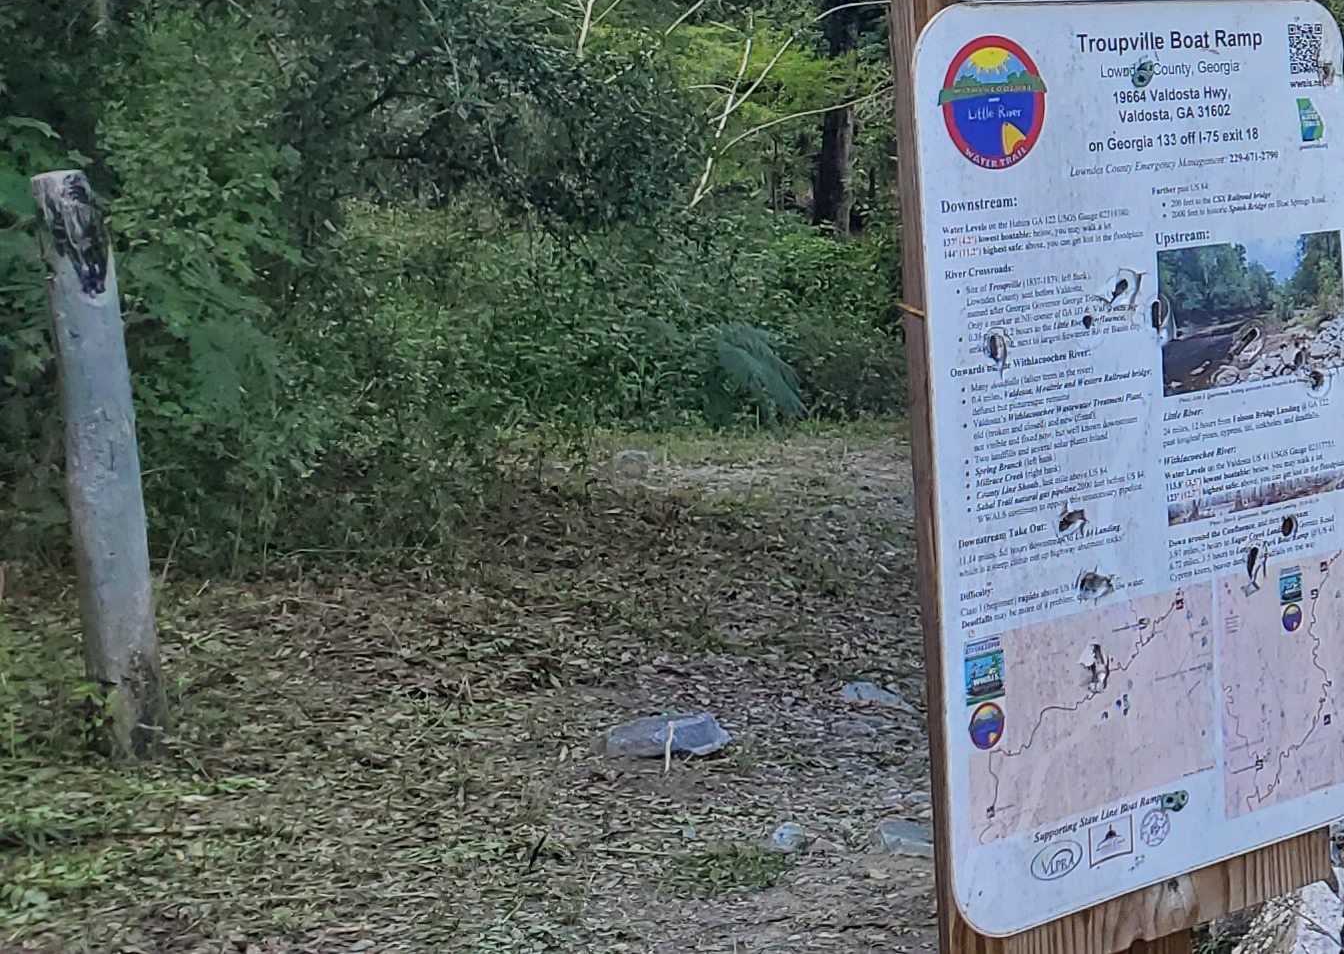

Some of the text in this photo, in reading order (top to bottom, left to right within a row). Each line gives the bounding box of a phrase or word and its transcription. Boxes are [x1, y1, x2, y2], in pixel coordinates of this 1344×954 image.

[1077, 29, 1262, 56] Troupville Boat Ramp
[1101, 59, 1240, 78] Lownd County, Georgia
[1112, 87, 1231, 104] 19664 Valdosta Hwy,
[1119, 104, 1231, 123] Valdosta, GA 31602
[1088, 127, 1259, 153] on Georgia 133 off I-75 exit 18
[965, 147, 1027, 168] WATER TRAIL
[1070, 162, 1104, 177] Lowndes
[1105, 159, 1132, 175] County
[1134, 157, 1176, 172] Emergency
[941, 196, 1018, 214] Downstream:
[1155, 229, 1210, 247] Upstream:
[945, 265, 1015, 280] River Crossroads:
[1068, 349, 1091, 360] River:
[1008, 527, 1028, 539] Take
[1029, 522, 1047, 534] Out:
[1034, 821, 1078, 843] Supporting
